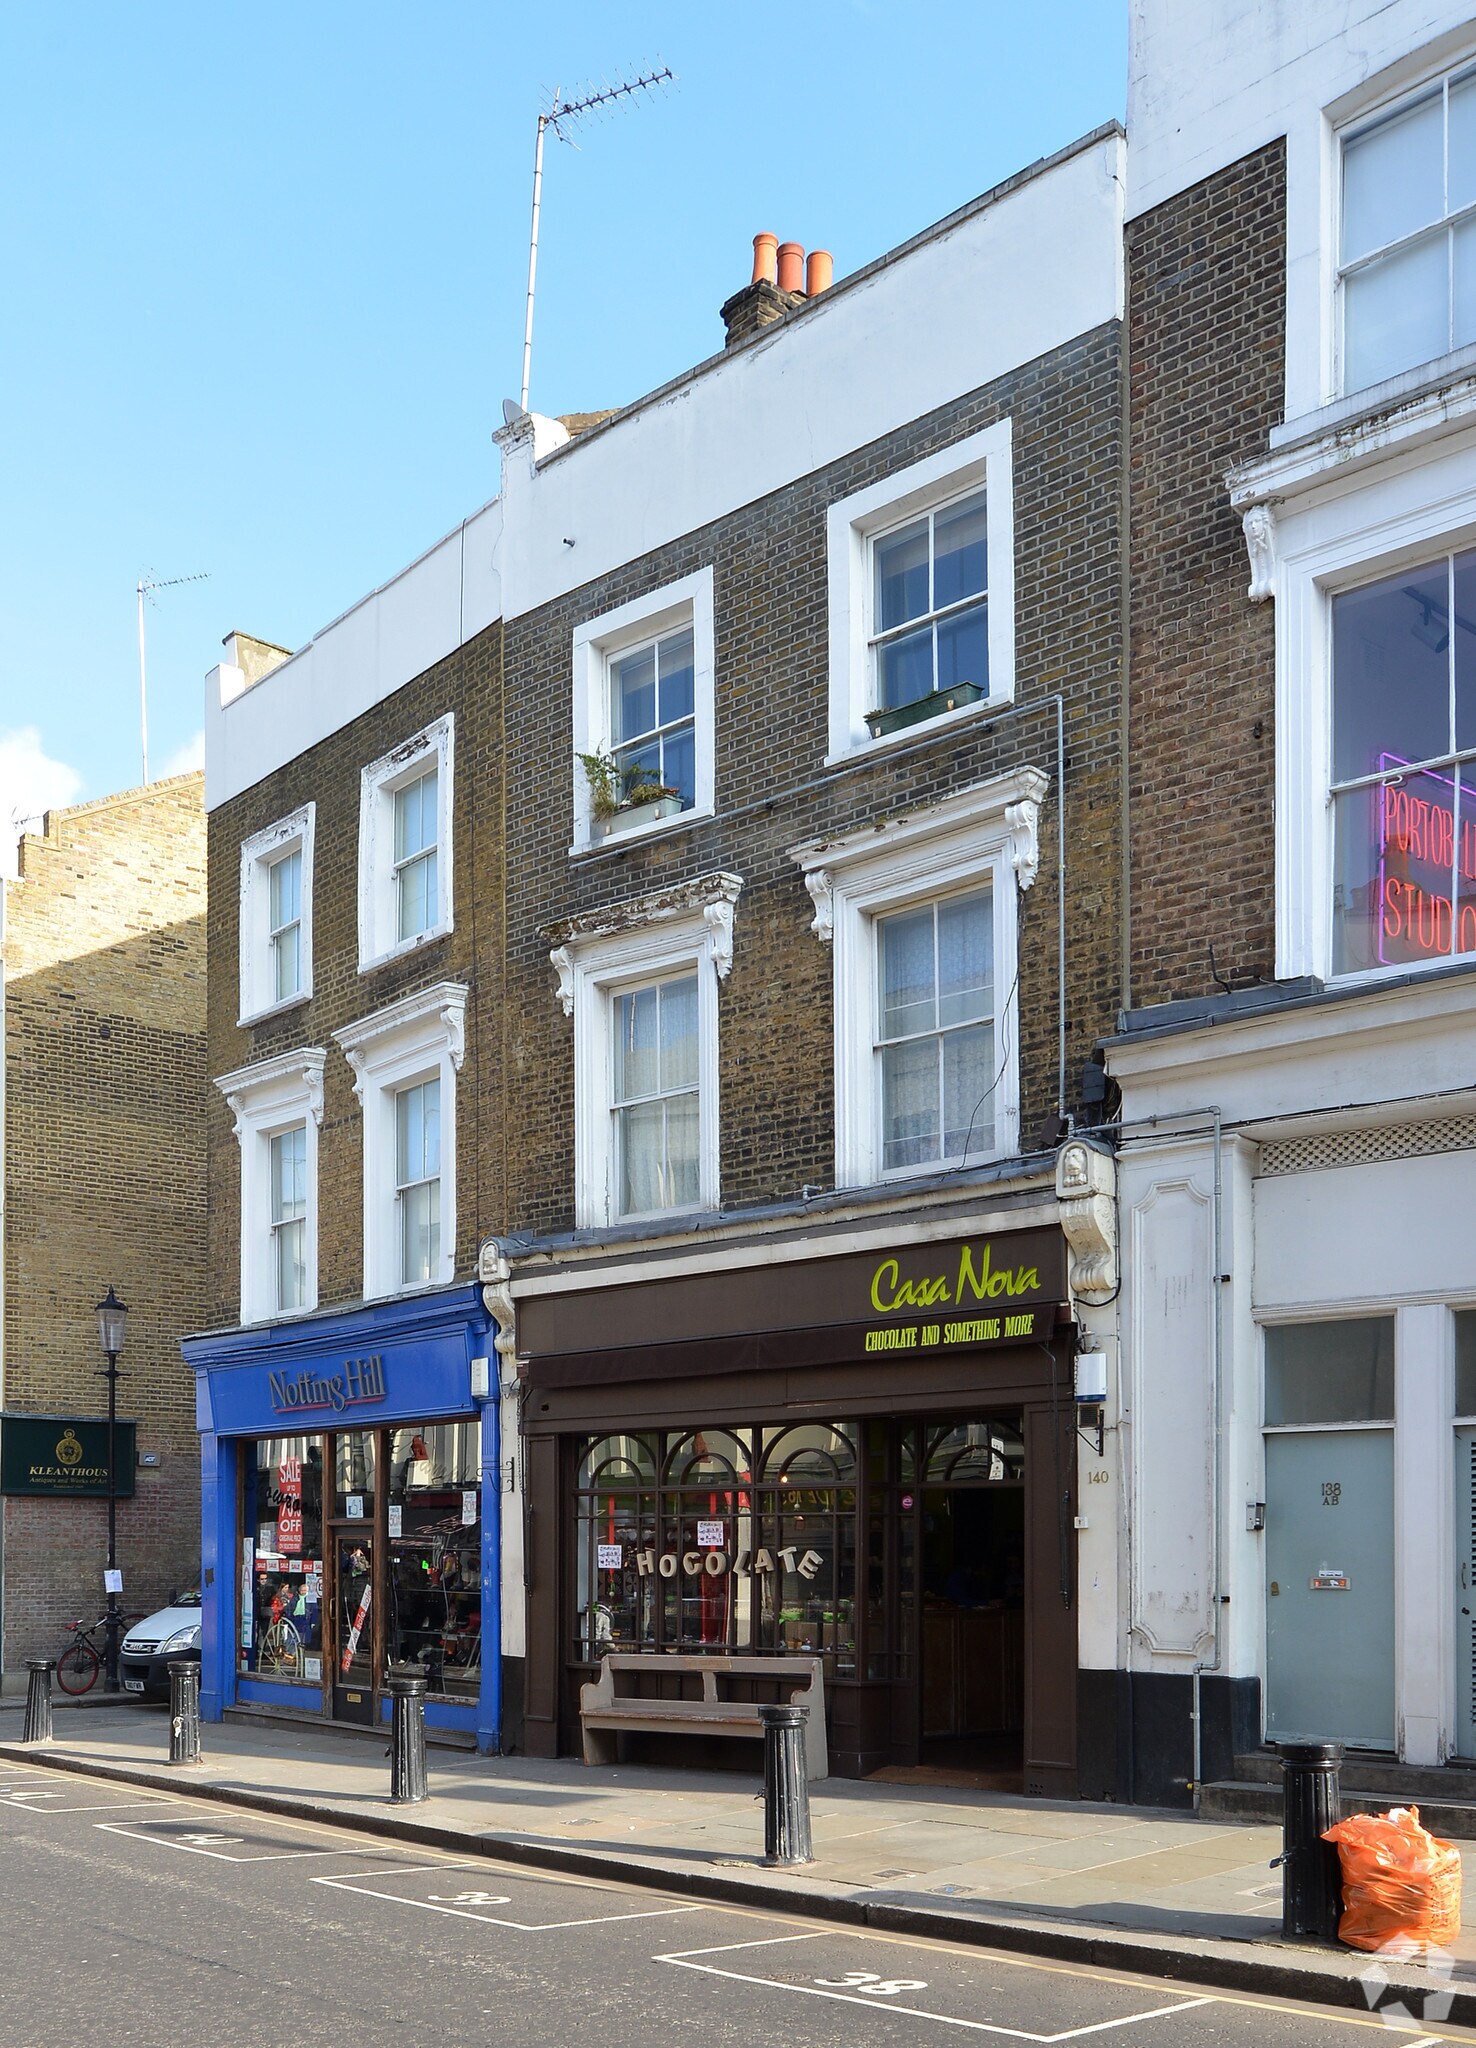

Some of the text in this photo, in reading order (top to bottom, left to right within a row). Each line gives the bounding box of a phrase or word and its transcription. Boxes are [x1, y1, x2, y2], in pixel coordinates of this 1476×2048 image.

[1385, 786, 1476, 880] PORTOBL
[1384, 878, 1476, 953] STUDO
[871, 1242, 1041, 1312] Casa Nova
[866, 1314, 1034, 1352] CHOCOLATE AND SOMETHING MORE
[267, 1354, 386, 1412] Notting Hill
[29, 1466, 109, 1477] KLEANTHOUS
[280, 1460, 301, 1483] SALE
[1088, 1470, 1109, 1484] 140
[1321, 1482, 1342, 1496] 138
[280, 1519, 302, 1532] OFF
[176, 1833, 244, 1845] 40
[428, 1891, 512, 1906] 39
[813, 1972, 929, 1995] 38
